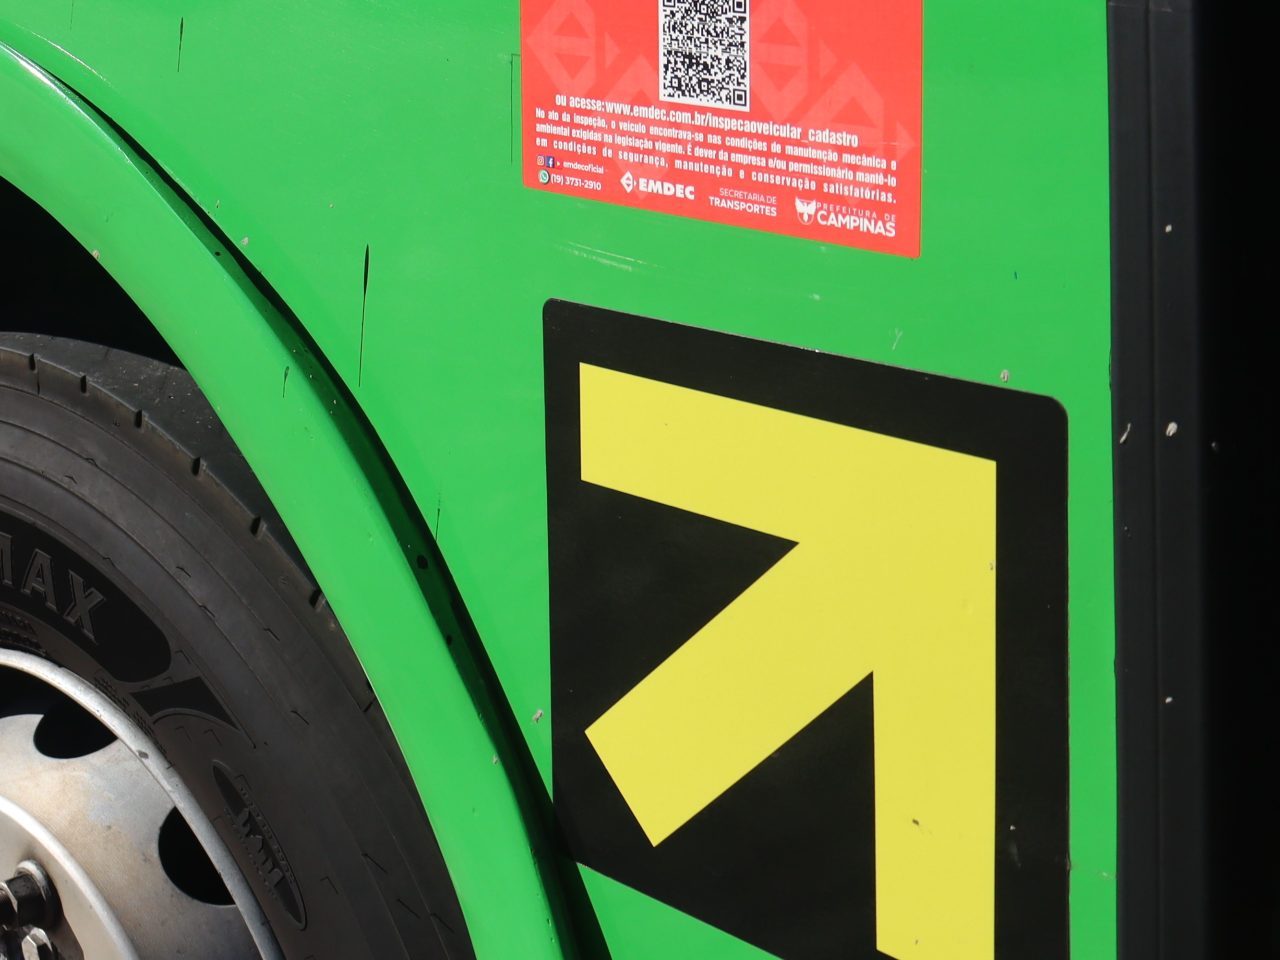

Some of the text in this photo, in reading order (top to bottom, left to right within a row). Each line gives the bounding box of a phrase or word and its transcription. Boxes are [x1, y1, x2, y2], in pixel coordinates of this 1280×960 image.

[555, 94, 567, 106] ou
[535, 107, 545, 119] No
[548, 109, 559, 120] ato
[562, 111, 570, 122] da
[573, 113, 608, 129] inspeção,
[619, 121, 646, 133] veículo
[649, 125, 704, 142] encontrava-se
[707, 133, 722, 145] nas
[725, 135, 768, 151] condições
[771, 141, 781, 153] de
[785, 145, 838, 163] manutenção
[842, 153, 887, 170] mecânica
[891, 160, 897, 171] e
[535, 123, 570, 137] ambiental
[572, 127, 602, 142] exigidas
[604, 134, 612, 143] na
[614, 134, 653, 150] legislação
[655, 140, 685, 155] vigente.
[687, 142, 692, 155] É
[694, 147, 716, 159] dever
[718, 149, 729, 161] da
[731, 151, 766, 167] empresa
[768, 157, 786, 171] e/ou
[788, 162, 853, 181] permissionário
[535, 137, 897, 204] em condições de segurança, manutenção e conservação satisfatórias.
[563, 160, 604, 174] emdecoficial
[551, 173, 602, 191] (19) 3731-2910
[638, 178, 695, 200] EMDEC
[708, 196, 777, 217] TRANSPORTES
[719, 188, 777, 205] SECRETARIA DE
[816, 201, 896, 222] PREFEITURA DE
[817, 210, 896, 237] CAMPINAS
